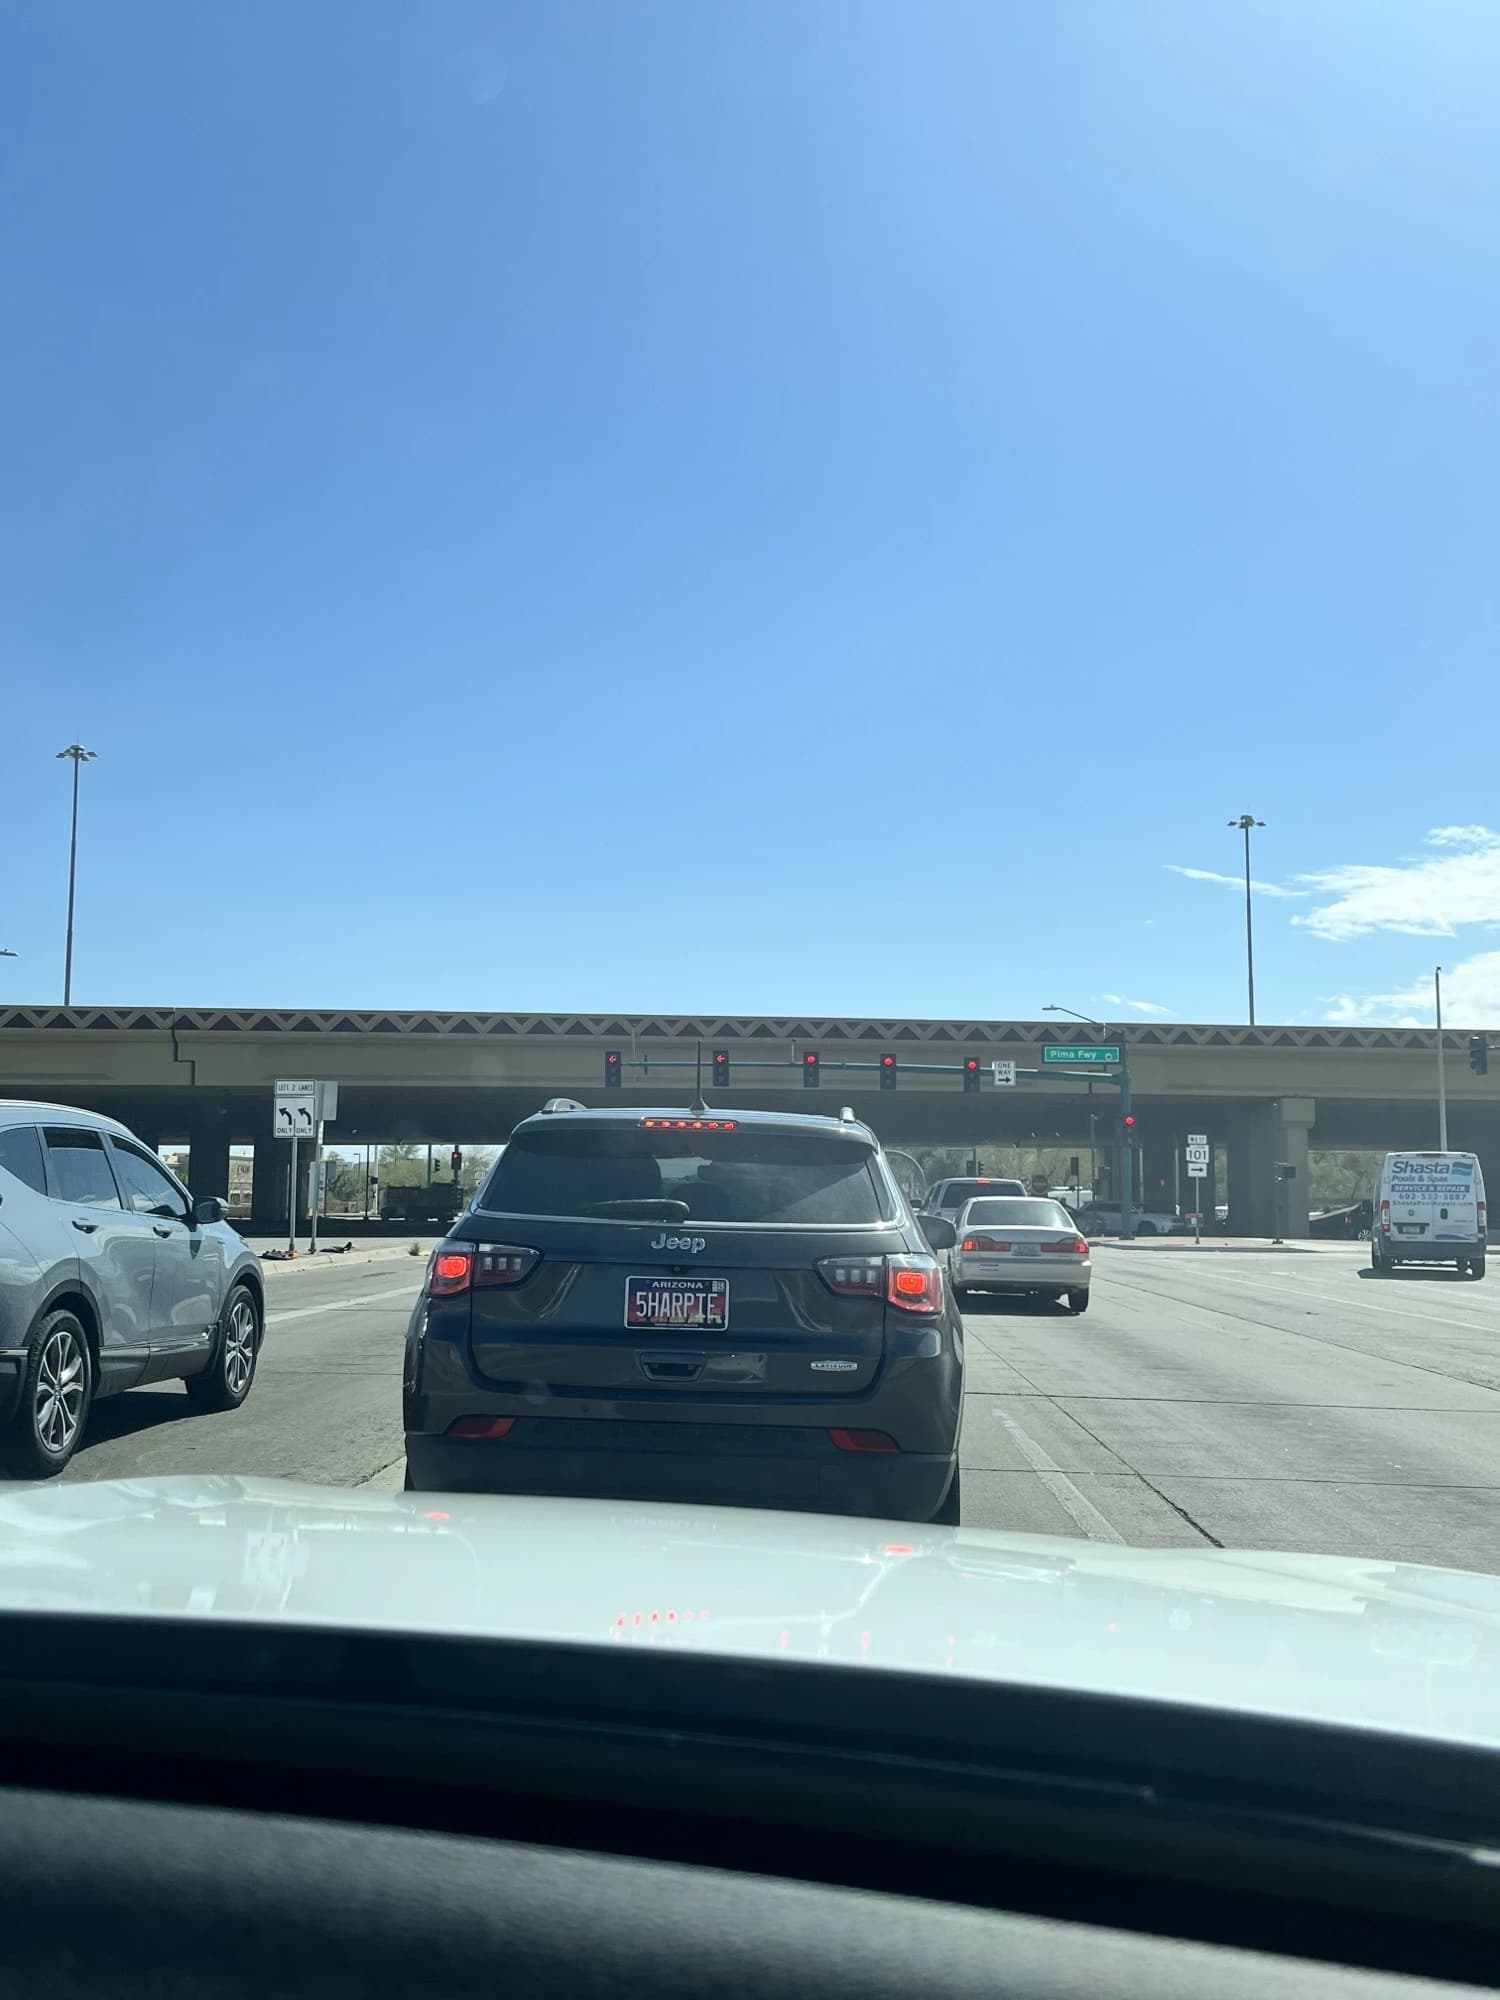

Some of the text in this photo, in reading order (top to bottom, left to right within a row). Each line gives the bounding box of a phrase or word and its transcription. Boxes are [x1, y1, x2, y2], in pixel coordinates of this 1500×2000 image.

[1050, 1050, 1097, 1060] Pima Fwy
[1188, 1150, 1206, 1161] 101
[1392, 1161, 1450, 1174] Shasta
[1427, 1175, 1448, 1183] Spas
[651, 1233, 705, 1253] Jeep
